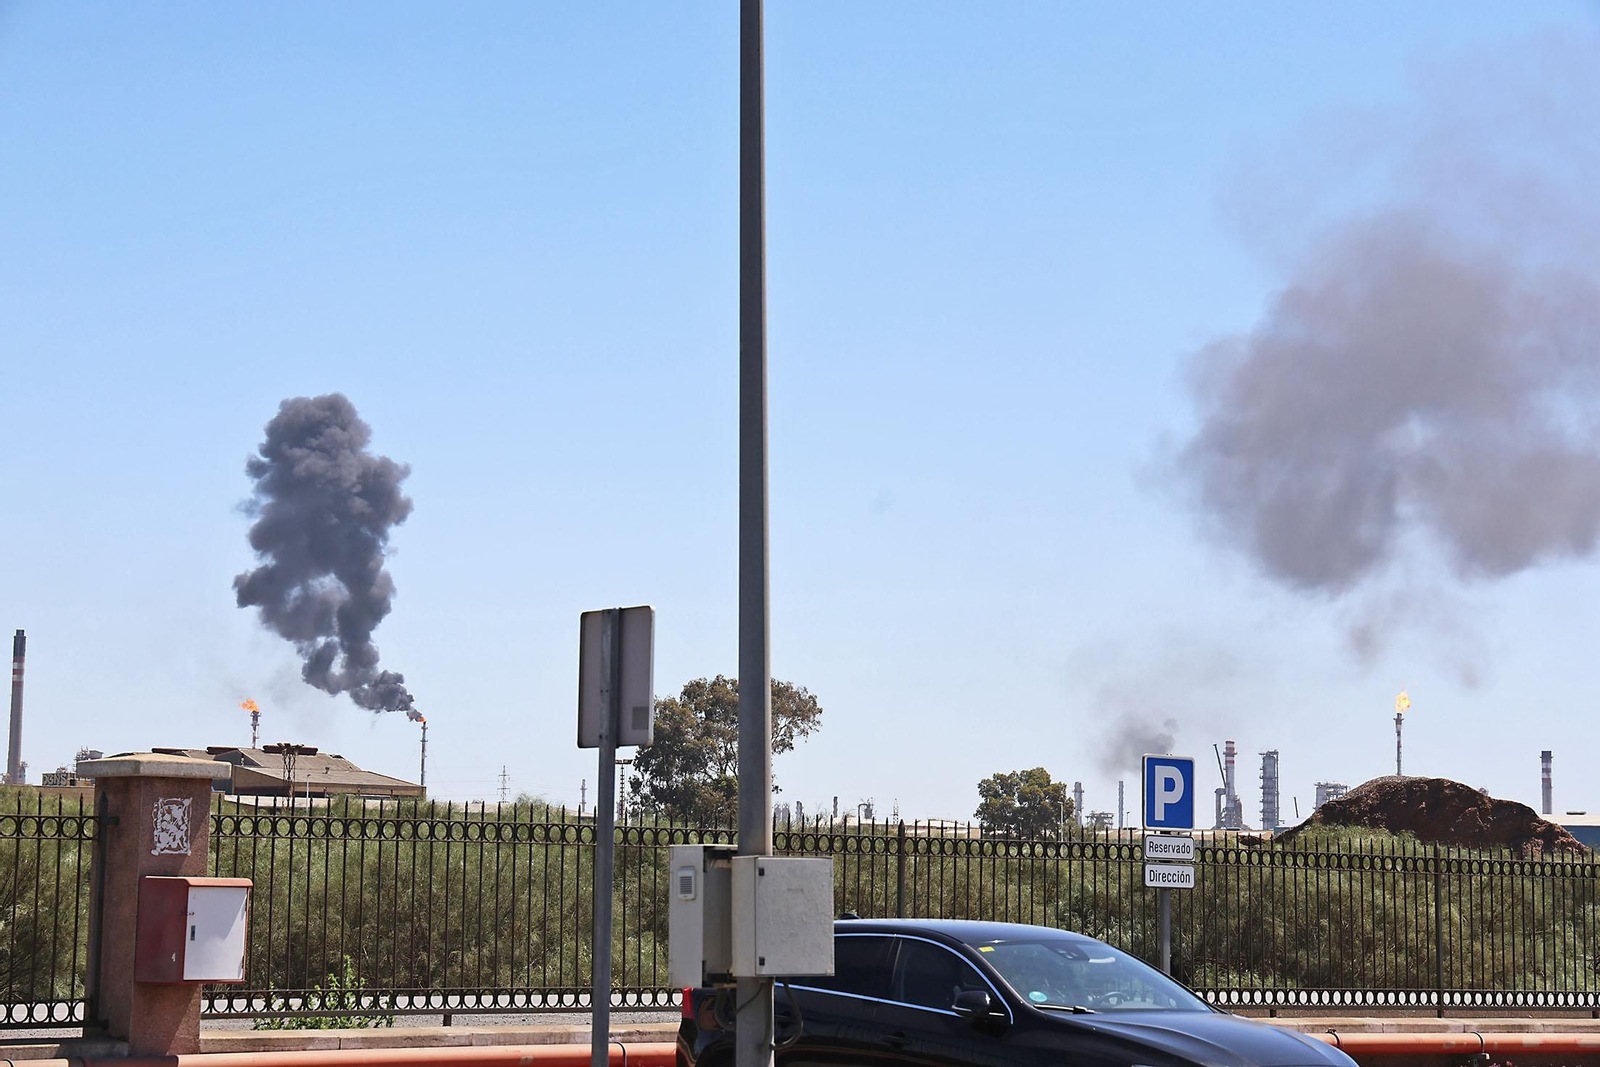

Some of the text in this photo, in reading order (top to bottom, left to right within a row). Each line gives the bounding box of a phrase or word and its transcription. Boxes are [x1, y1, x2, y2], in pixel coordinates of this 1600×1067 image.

[1154, 765, 1185, 821] P
[1148, 841, 1191, 854] Reservado
[1149, 869, 1191, 884] Dirección
